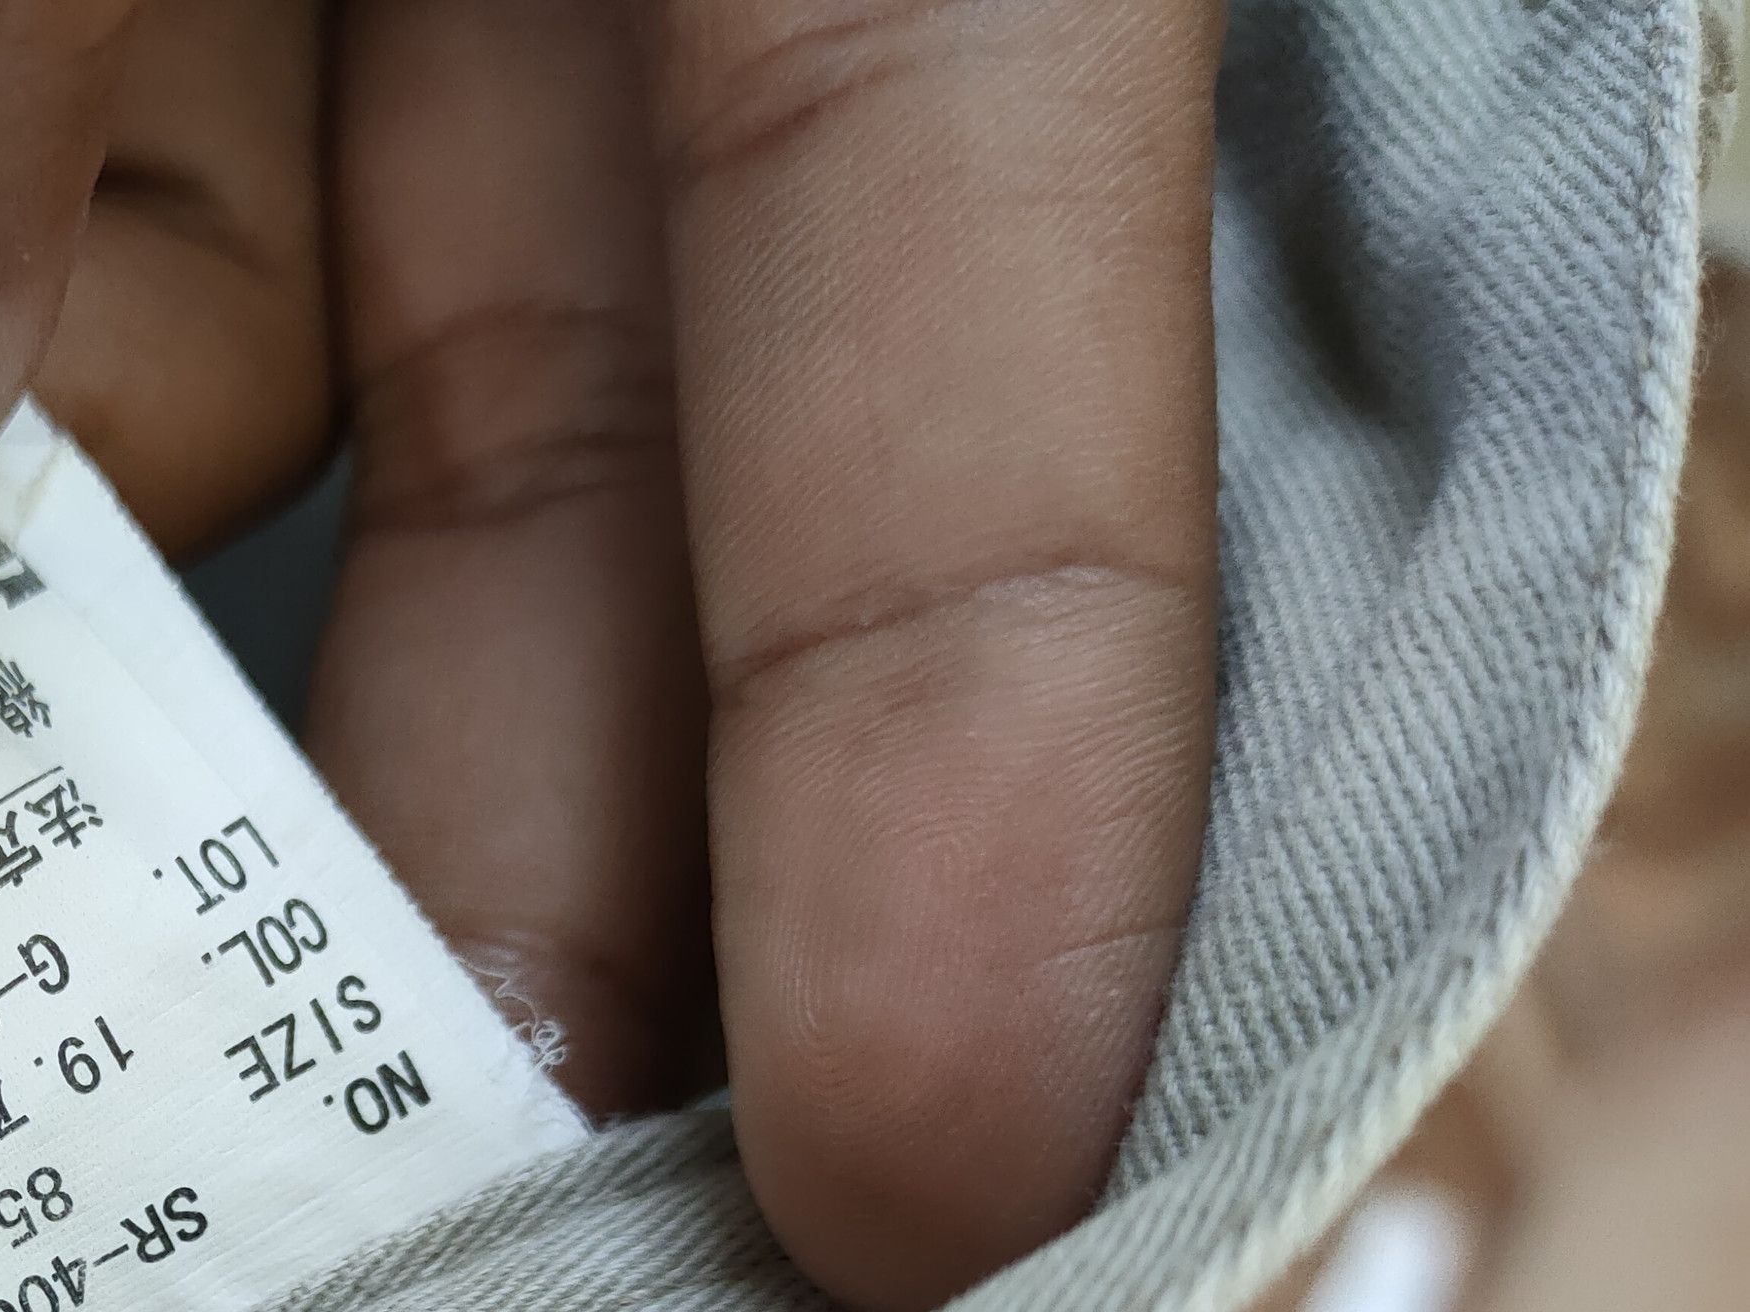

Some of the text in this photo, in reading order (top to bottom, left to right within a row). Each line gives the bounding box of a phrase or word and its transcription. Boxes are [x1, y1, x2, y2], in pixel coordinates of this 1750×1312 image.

[153, 816, 279, 915] LOT.
[201, 898, 328, 982] COL.
[228, 975, 381, 1103] SIZE
[323, 1050, 431, 1135] NO.
